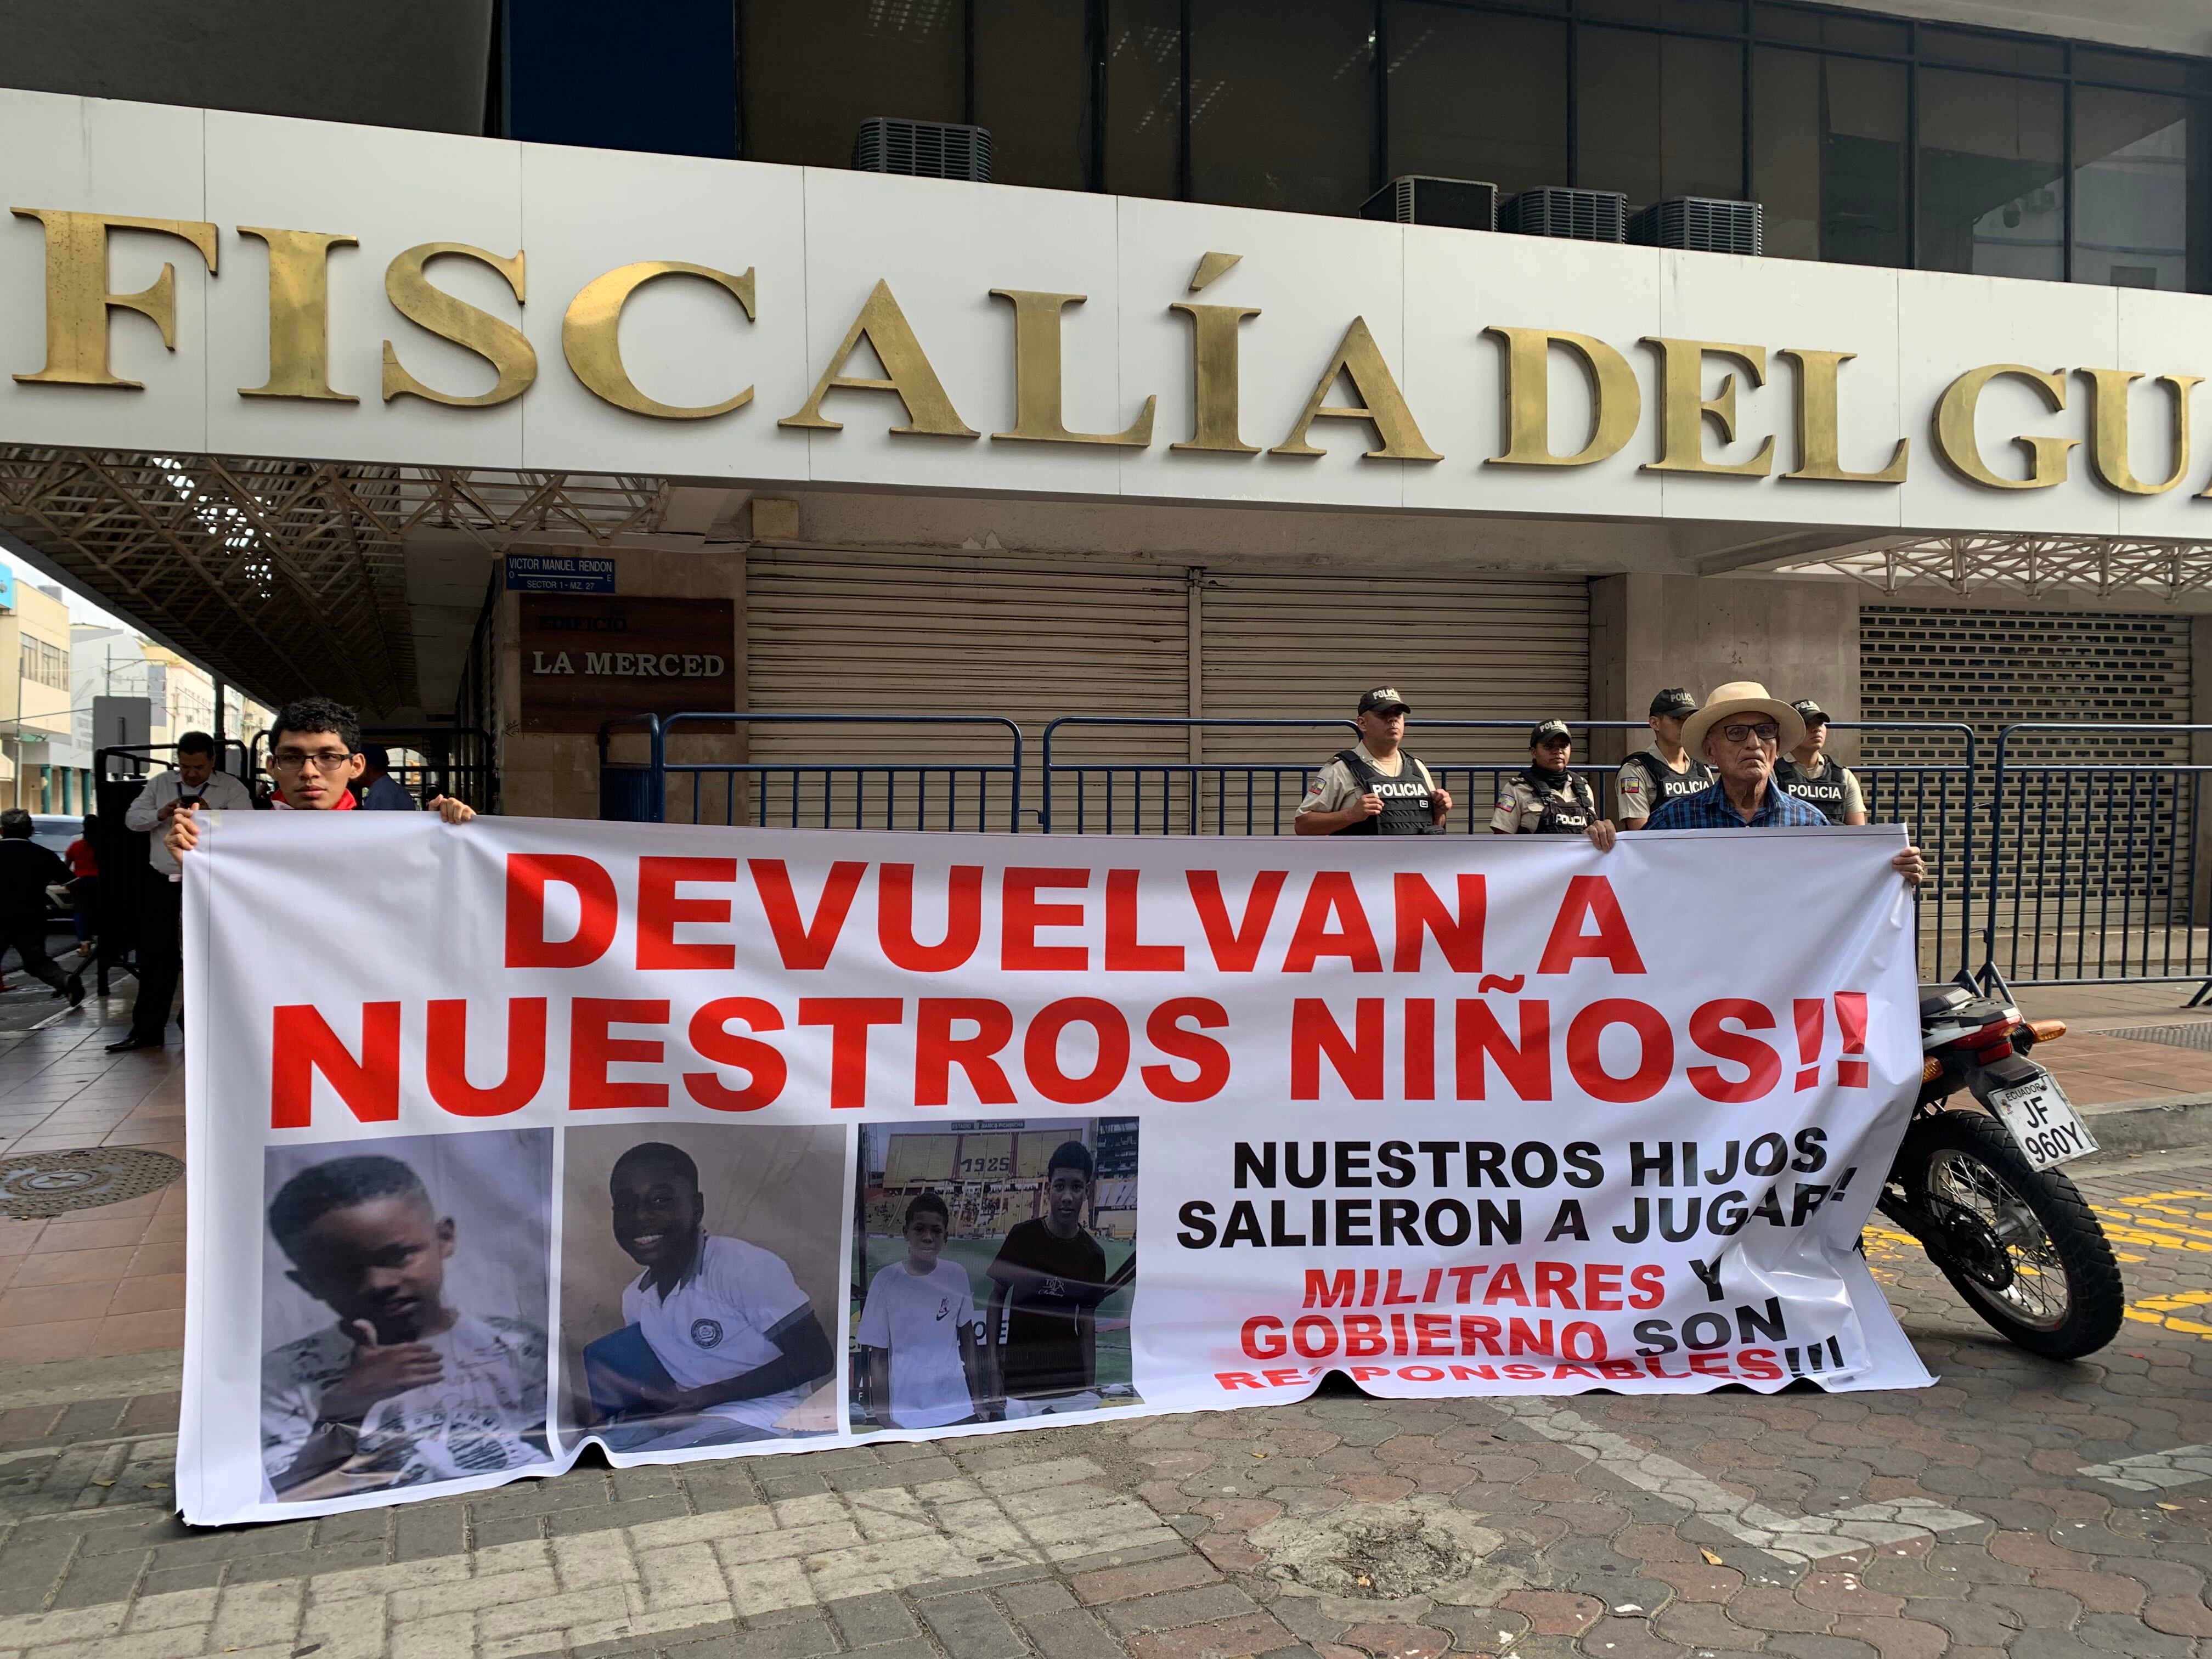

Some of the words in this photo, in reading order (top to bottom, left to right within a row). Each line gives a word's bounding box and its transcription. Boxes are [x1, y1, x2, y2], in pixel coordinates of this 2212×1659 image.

[10, 206, 1445, 461] FISCALÍA
[1483, 325, 1910, 483] DEL
[1931, 363, 2212, 498] GU
[509, 558, 539, 569] VICTOR
[542, 559, 575, 571] MANUEL
[579, 560, 612, 572] RENDON
[509, 571, 515, 579] O
[527, 580, 557, 589] SECTOR
[538, 614, 628, 632] EDIFICIO
[533, 651, 574, 675] LA
[585, 652, 725, 677] MERCED
[1671, 692, 1695, 703] POLIC
[1372, 783, 1428, 799] POLICIA
[1665, 781, 1709, 795] POLICIA
[1788, 785, 1842, 799] POLICIA
[1556, 814, 1587, 826] POLICIA
[505, 853, 1486, 973] DEVUELVAN
[1538, 875, 1646, 974] A
[271, 996, 1231, 1128] NUESTROS
[1290, 974, 1869, 1104] NIÑOS!!
[2005, 1082, 2041, 1102] ECUADOR
[2023, 1096, 2049, 1129] JF
[2025, 1121, 2084, 1164] 960Y
[961, 1157, 1009, 1172] 1925
[1234, 1141, 1604, 1189] NUESTROS
[1630, 1127, 1827, 1187] HIJOS
[1177, 1199, 1522, 1249] SALIERON
[1544, 1199, 1590, 1242] A
[1302, 1261, 1666, 1311] MILITARES
[1688, 1251, 1725, 1302] Y
[1240, 1313, 1607, 1362] GOBIERNO
[1633, 1296, 1787, 1357] SON
